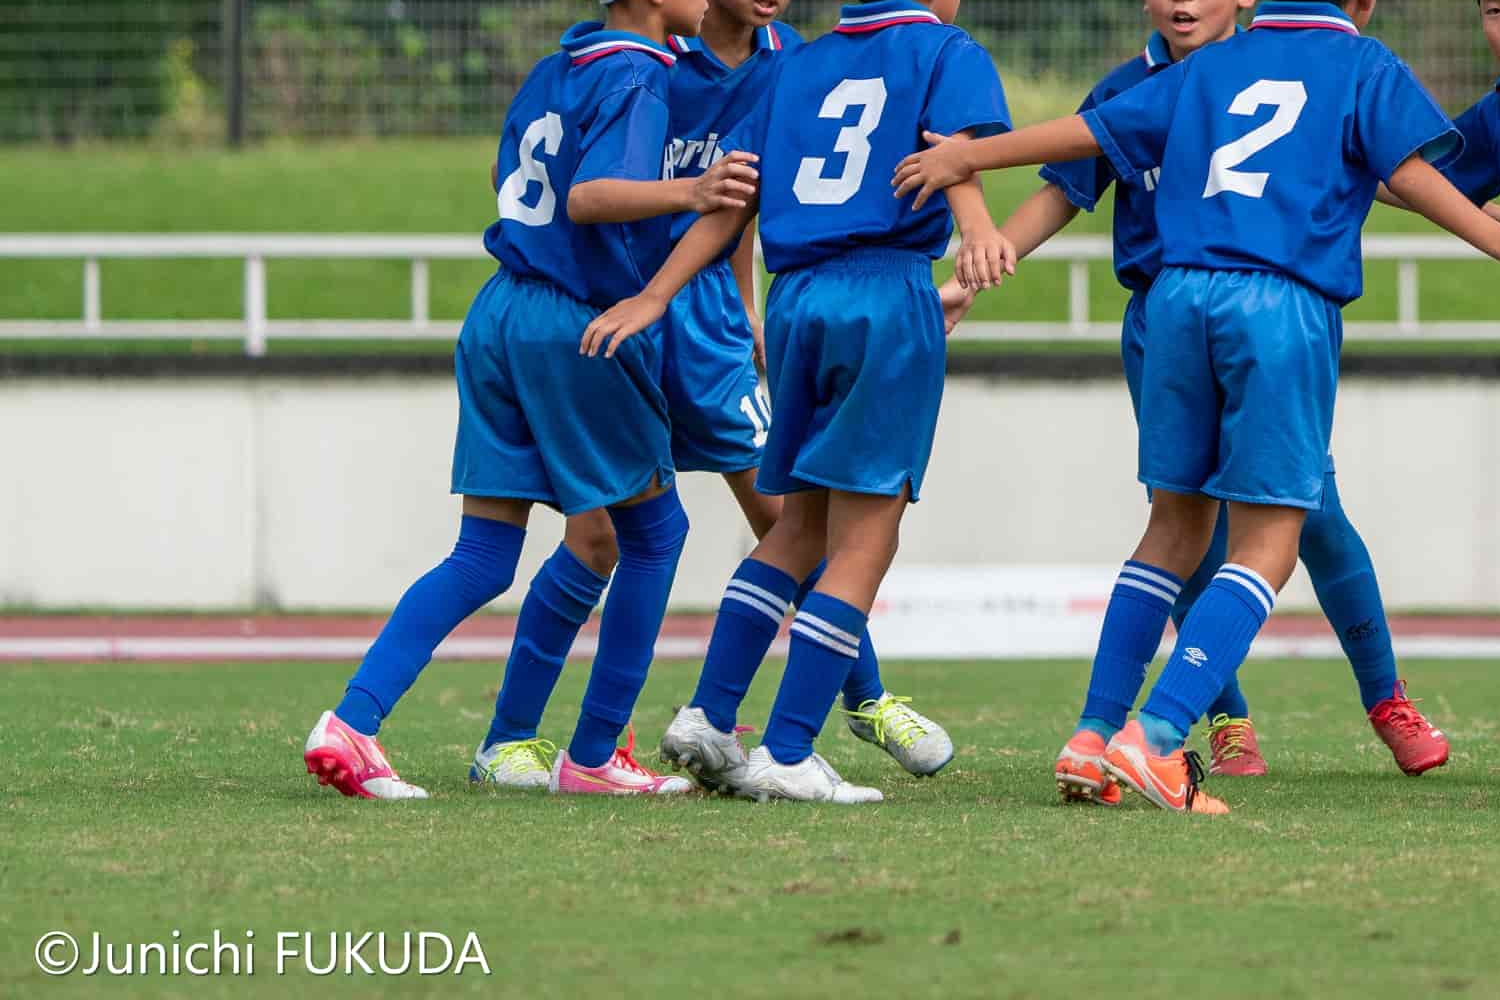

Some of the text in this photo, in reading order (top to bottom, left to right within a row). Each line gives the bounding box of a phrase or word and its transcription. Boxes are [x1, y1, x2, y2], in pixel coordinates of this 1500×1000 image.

[497, 111, 564, 226] 6
[793, 77, 887, 204] 3
[1202, 79, 1308, 199] 2
